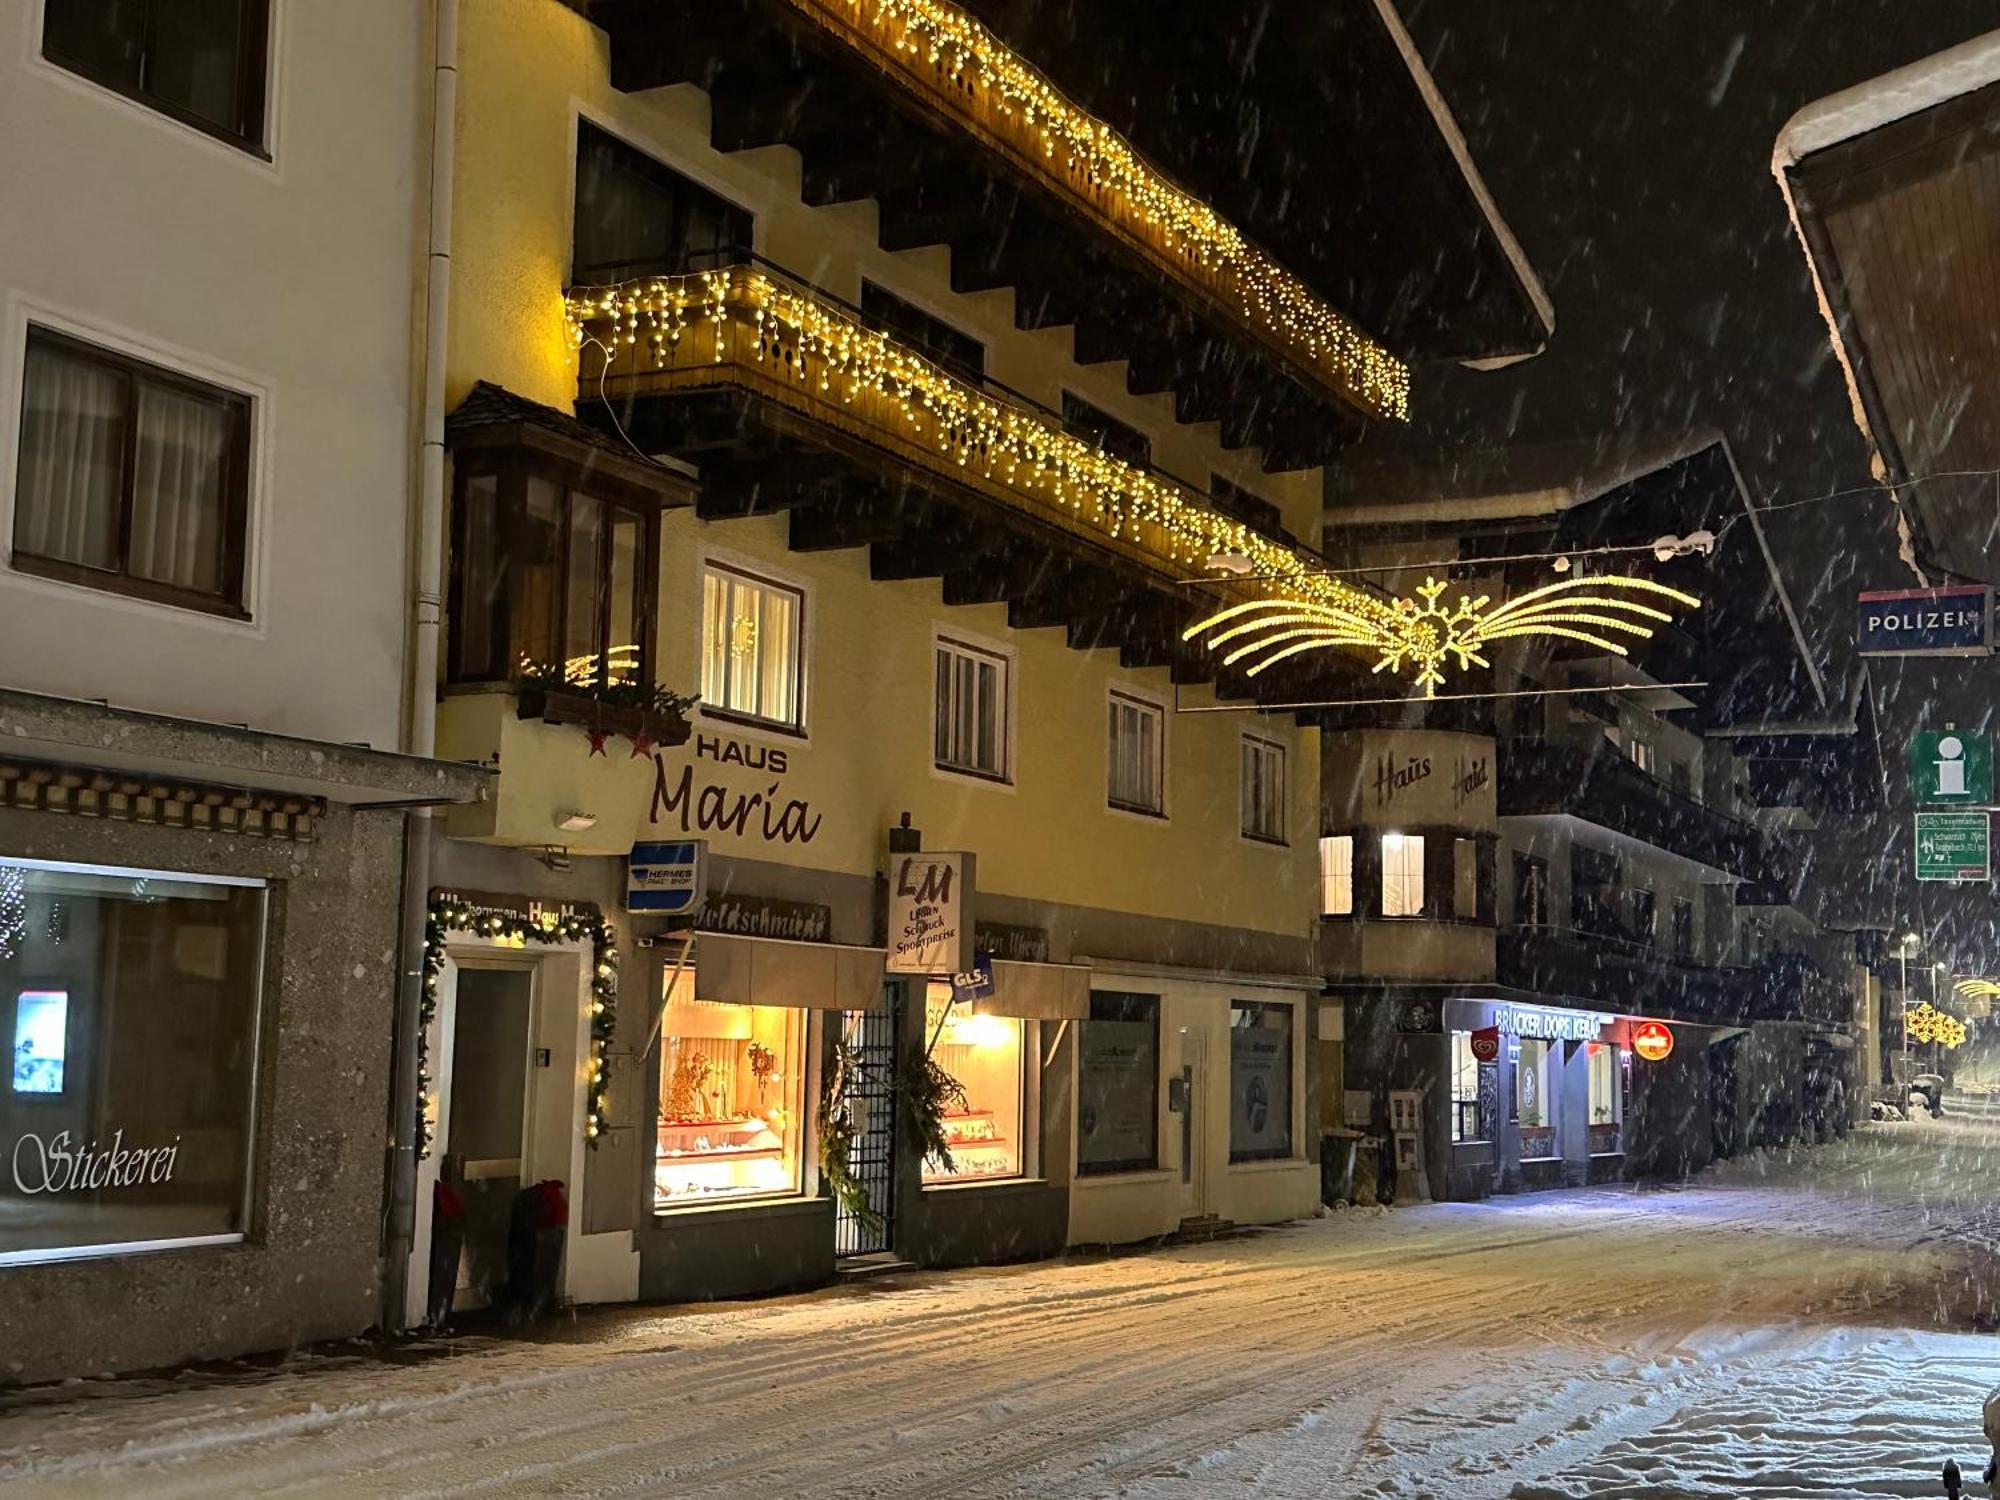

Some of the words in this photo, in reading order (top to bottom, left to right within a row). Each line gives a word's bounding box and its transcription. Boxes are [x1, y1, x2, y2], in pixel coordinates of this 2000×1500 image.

[1868, 611, 1964, 632] POLIZEI
[697, 734, 787, 774] HAUS
[648, 869, 693, 878] HERMES
[897, 857, 953, 904] LM
[954, 969, 983, 987] GLS
[13, 1128, 180, 1194] Stickerei
